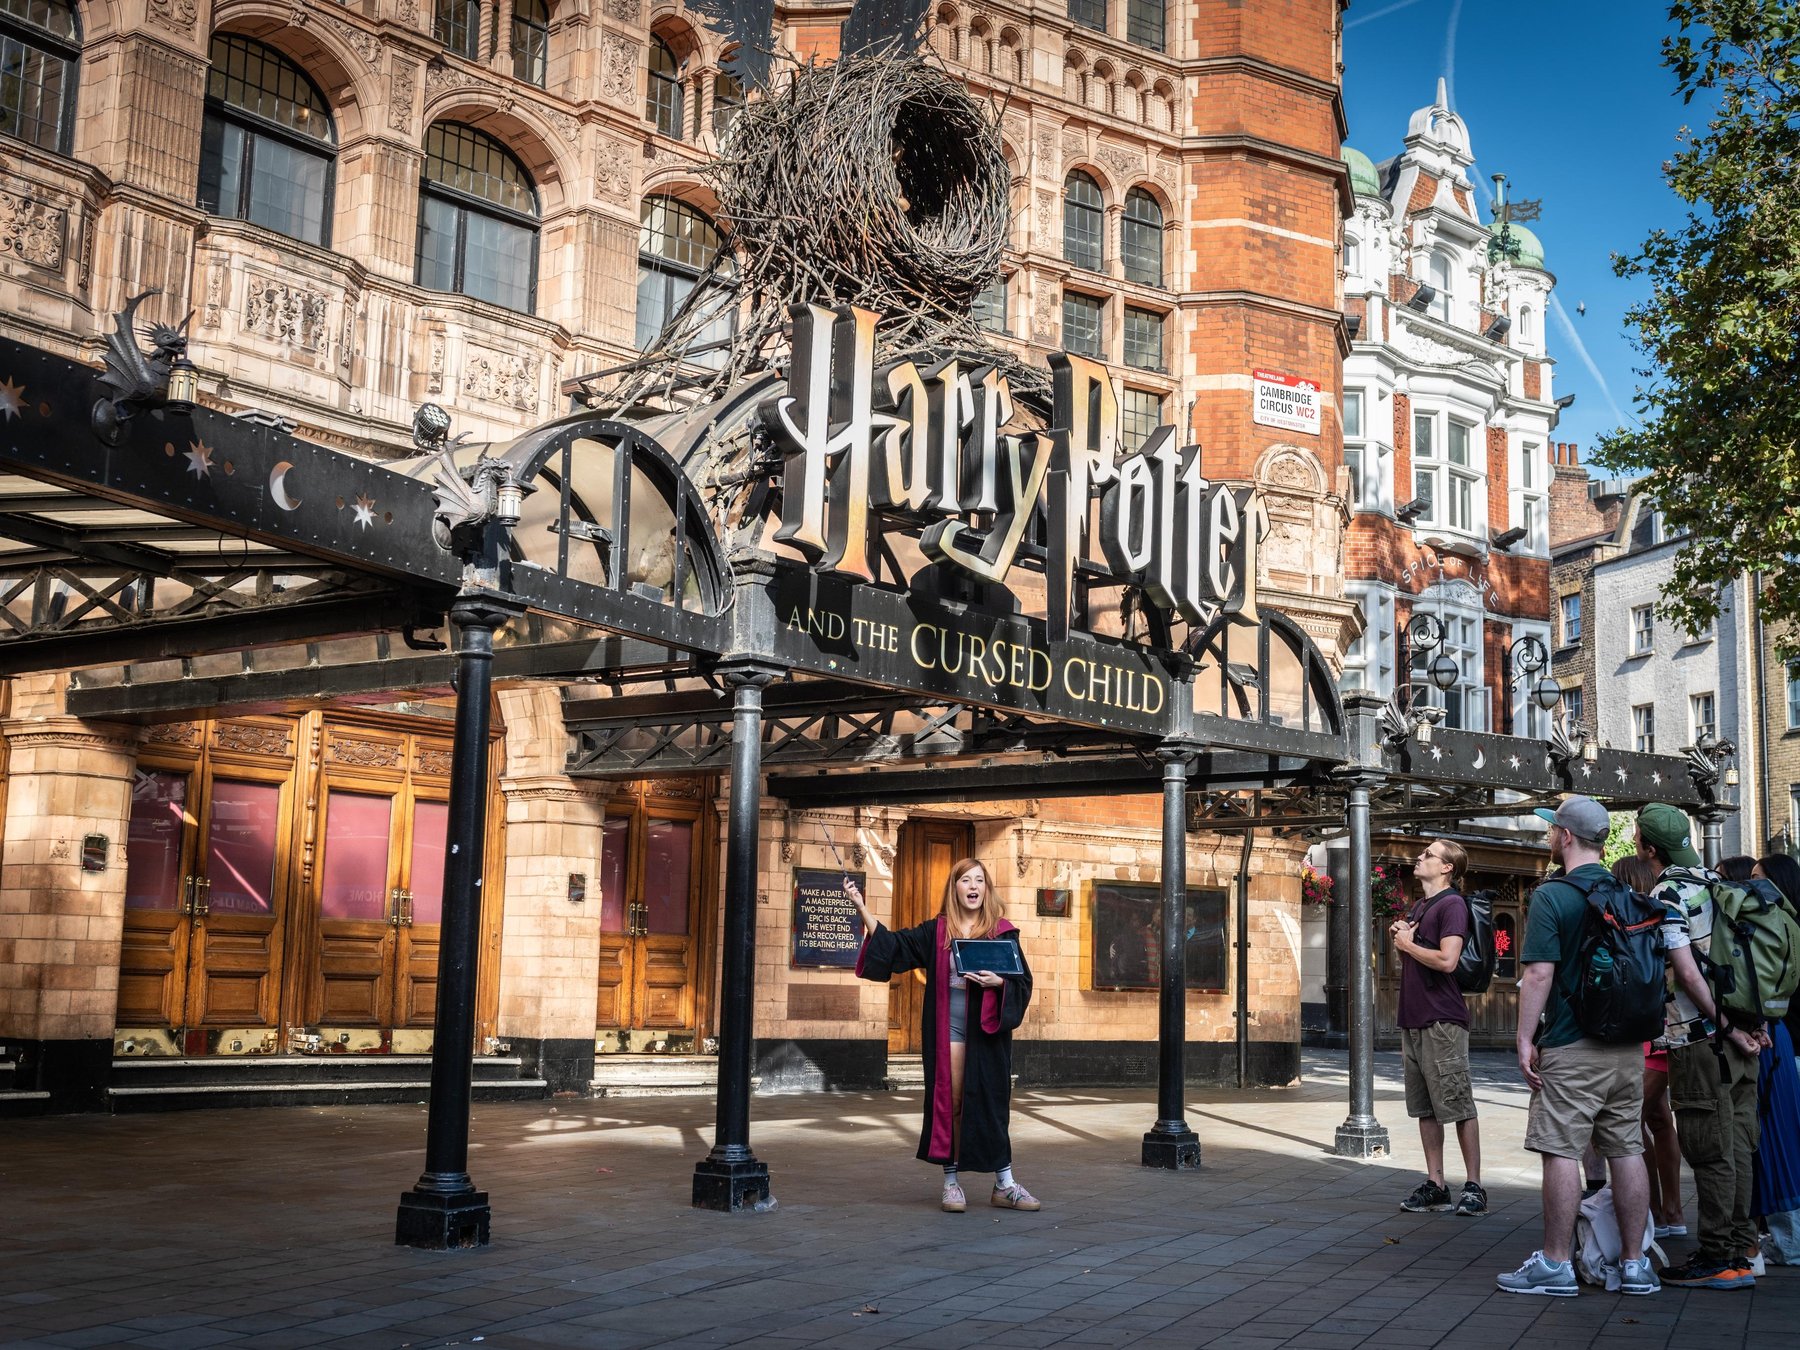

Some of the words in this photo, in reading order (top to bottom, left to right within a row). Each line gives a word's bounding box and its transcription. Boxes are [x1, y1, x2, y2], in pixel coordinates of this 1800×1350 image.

[1260, 385, 1312, 406] CAMBRIDGE
[1260, 398, 1293, 415] CIRCUS
[1296, 405, 1315, 420] WC2
[776, 303, 1054, 583] Harry
[1060, 353, 1270, 640] Potter
[1402, 553, 1445, 584] SPICE
[1450, 556, 1463, 568] OF
[786, 605, 845, 640] AND
[852, 618, 899, 653] THE
[911, 623, 1053, 692] CURSED
[1064, 657, 1165, 714] CHILD
[801, 905, 833, 914] TWO-PART
[834, 908, 857, 916] POTTER
[817, 932, 855, 941] RECOVERED
[820, 923, 836, 931] WEST
[799, 939, 808, 947] ITS
[809, 940, 836, 949] BEATING
